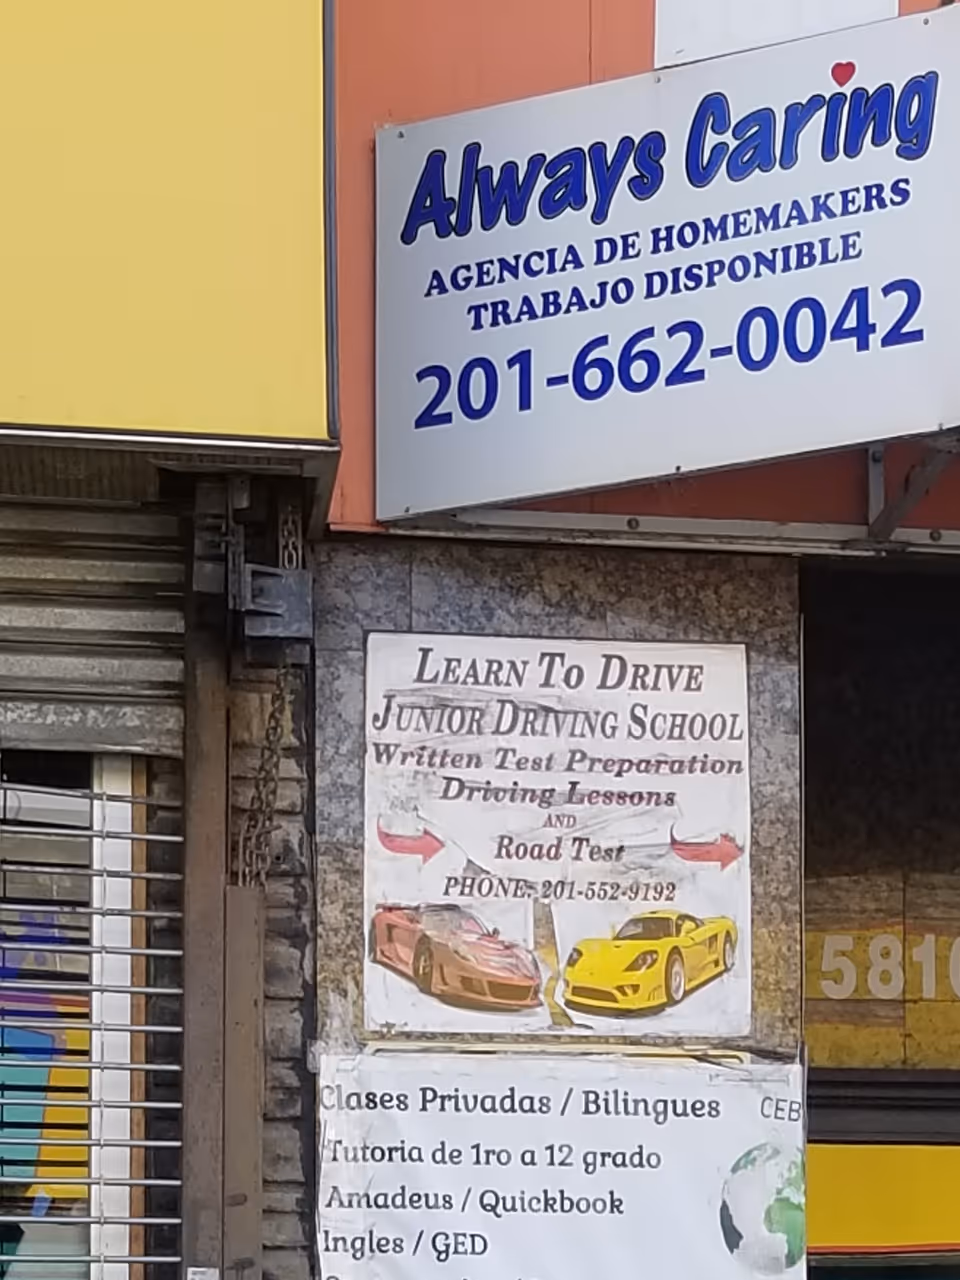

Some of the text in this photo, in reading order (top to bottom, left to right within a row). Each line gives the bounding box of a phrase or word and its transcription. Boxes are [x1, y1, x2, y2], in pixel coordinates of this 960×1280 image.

[401, 68, 939, 244] Always Caring
[424, 178, 911, 297] AGENCIA DE HOMEMAKERS
[467, 231, 862, 331] TRABAJO DISPONIBLE
[414, 278, 925, 429] 201-662-0042
[413, 647, 530, 687] LEARN
[597, 654, 704, 692] DRIVE
[372, 695, 743, 741] JUNIOR DRIVING SCHOOL
[373, 743, 743, 777] Written Test Preparation
[440, 776, 676, 808] Driving Lessons
[543, 814, 577, 829] AND
[494, 836, 625, 862] Road Test
[540, 880, 677, 902] 201-552-9192
[320, 1084, 801, 1125] Clases Privadas / Bilingues CEB
[328, 1139, 662, 1175] Tutoria de 1ro a 12 grado
[325, 1185, 624, 1218] Amadeus / Quickbook
[323, 1230, 488, 1262] Ingles / GED
